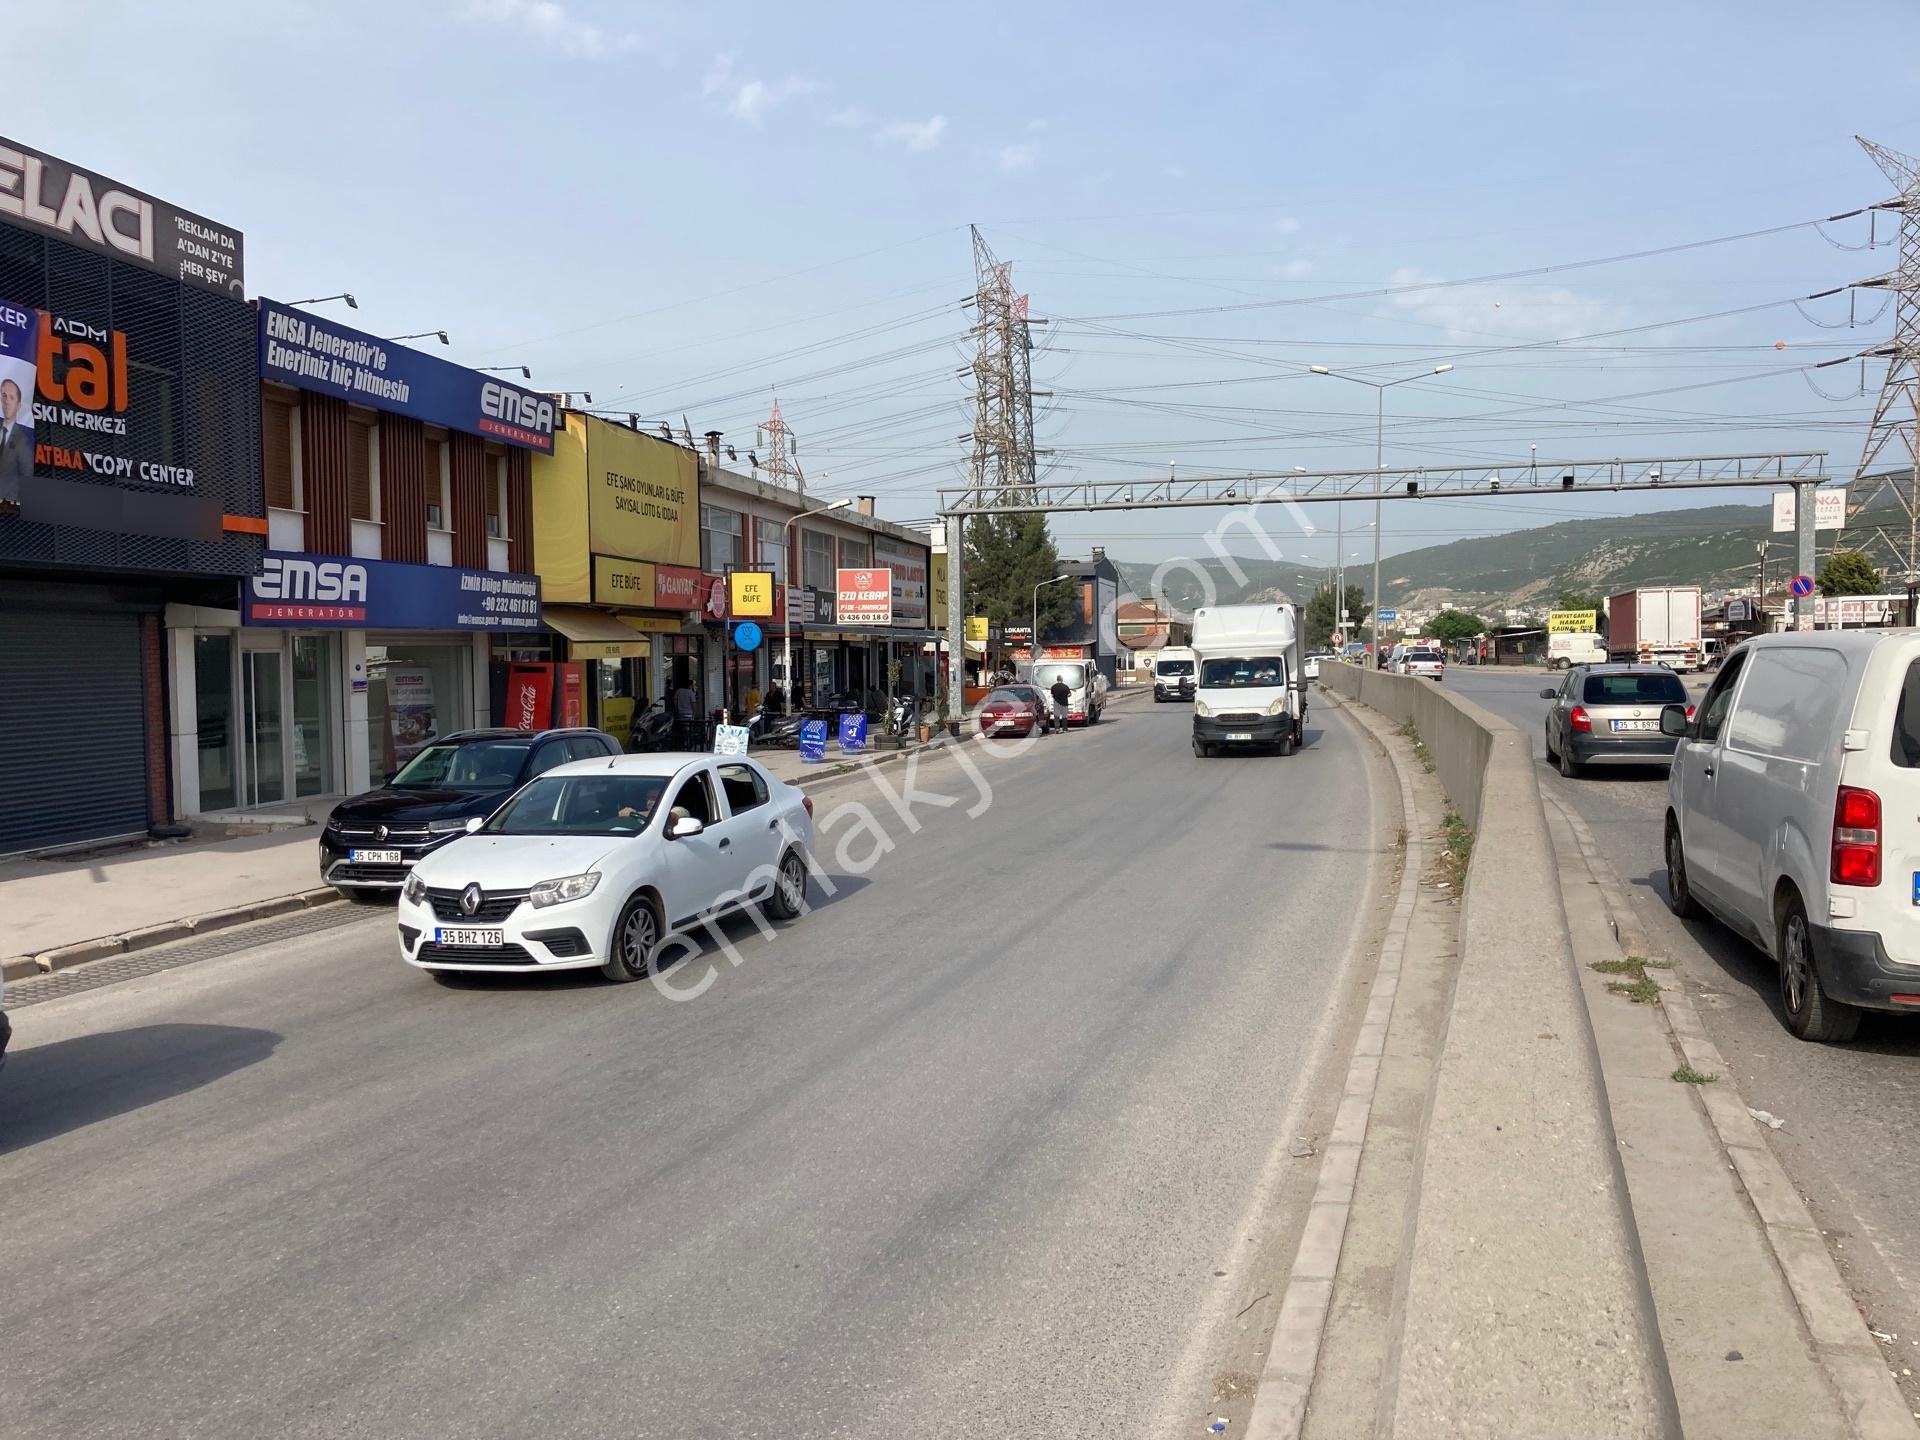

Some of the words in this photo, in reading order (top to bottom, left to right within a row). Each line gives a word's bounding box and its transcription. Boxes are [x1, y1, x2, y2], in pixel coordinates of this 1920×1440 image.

[221, 233, 235, 250] DA
[177, 238, 210, 261] A'DAN
[211, 251, 233, 268] Z'YE
[54, 317, 107, 342] ADM
[266, 310, 307, 346] EMSA
[308, 325, 387, 371] Jeneratör'le
[37, 316, 128, 412] tal
[267, 340, 330, 381] Enerjiniz
[331, 360, 353, 391] hiç
[354, 367, 410, 403] bitmesin
[32, 402, 57, 423] SKI
[481, 382, 553, 434] EMSA
[489, 424, 543, 444] JENERATÖR
[92, 454, 133, 477] COPY
[140, 461, 194, 486] CENTER
[607, 472, 618, 488] EFE
[636, 480, 666, 499] OYUNLARI
[666, 487, 670, 501] &
[671, 487, 685, 504] BÜFE
[616, 495, 640, 515] SAYISAL
[642, 501, 655, 518] LOTO
[657, 505, 661, 518] &
[252, 557, 368, 602] EMSA
[481, 577, 501, 594] Bölge
[612, 573, 624, 589] EFE
[625, 572, 641, 590] BÜFE
[745, 585, 758, 593] EFE
[481, 597, 495, 611] +90
[495, 597, 508, 612] 232
[509, 598, 520, 613] 461
[521, 599, 529, 613] 81
[530, 600, 537, 614] 81
[742, 593, 761, 603] BÜFE
[858, 591, 888, 601] KEBAP
[268, 607, 355, 618] JENERATÖR
[820, 598, 833, 622] Joy
[847, 727, 858, 737] +1
[1619, 721, 1628, 729] 35
[1633, 721, 1639, 729] S
[355, 851, 364, 861] 35
[367, 851, 382, 861] CPH
[385, 852, 399, 861] 168
[442, 930, 455, 943] 35
[457, 931, 478, 944] BHZ
[481, 932, 501, 944] 126
